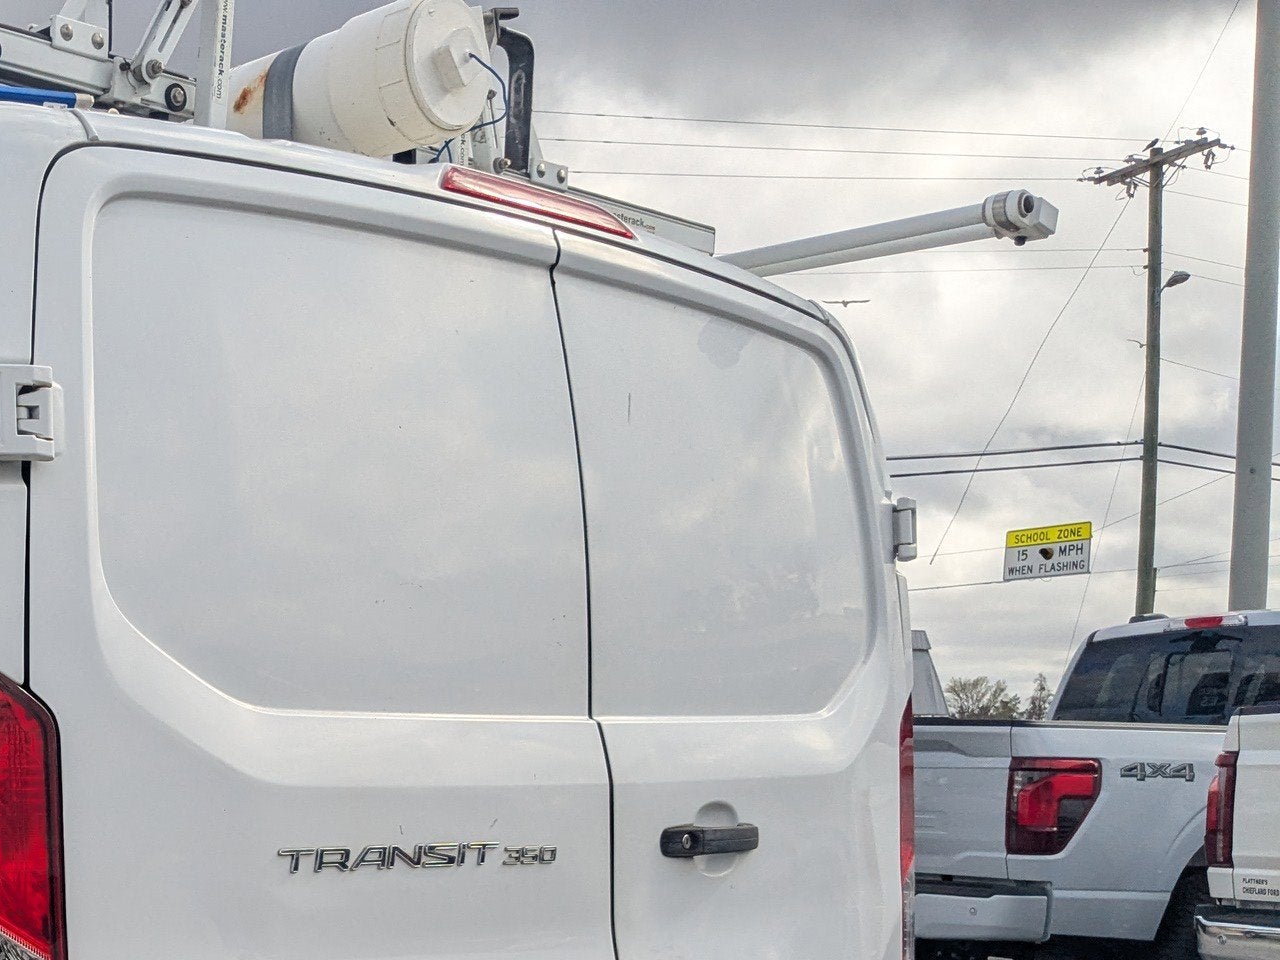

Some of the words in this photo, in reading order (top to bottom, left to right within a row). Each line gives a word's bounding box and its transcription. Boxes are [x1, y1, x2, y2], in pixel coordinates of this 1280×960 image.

[1014, 531, 1051, 545] SCHOOL
[1056, 527, 1083, 540] ZONE
[1017, 549, 1029, 562] 15
[1058, 543, 1084, 557] MPH
[1007, 564, 1033, 577] WHEN
[1038, 560, 1085, 574] FLASHING
[278, 841, 500, 875] TRANSIT
[502, 845, 558, 866] 350
